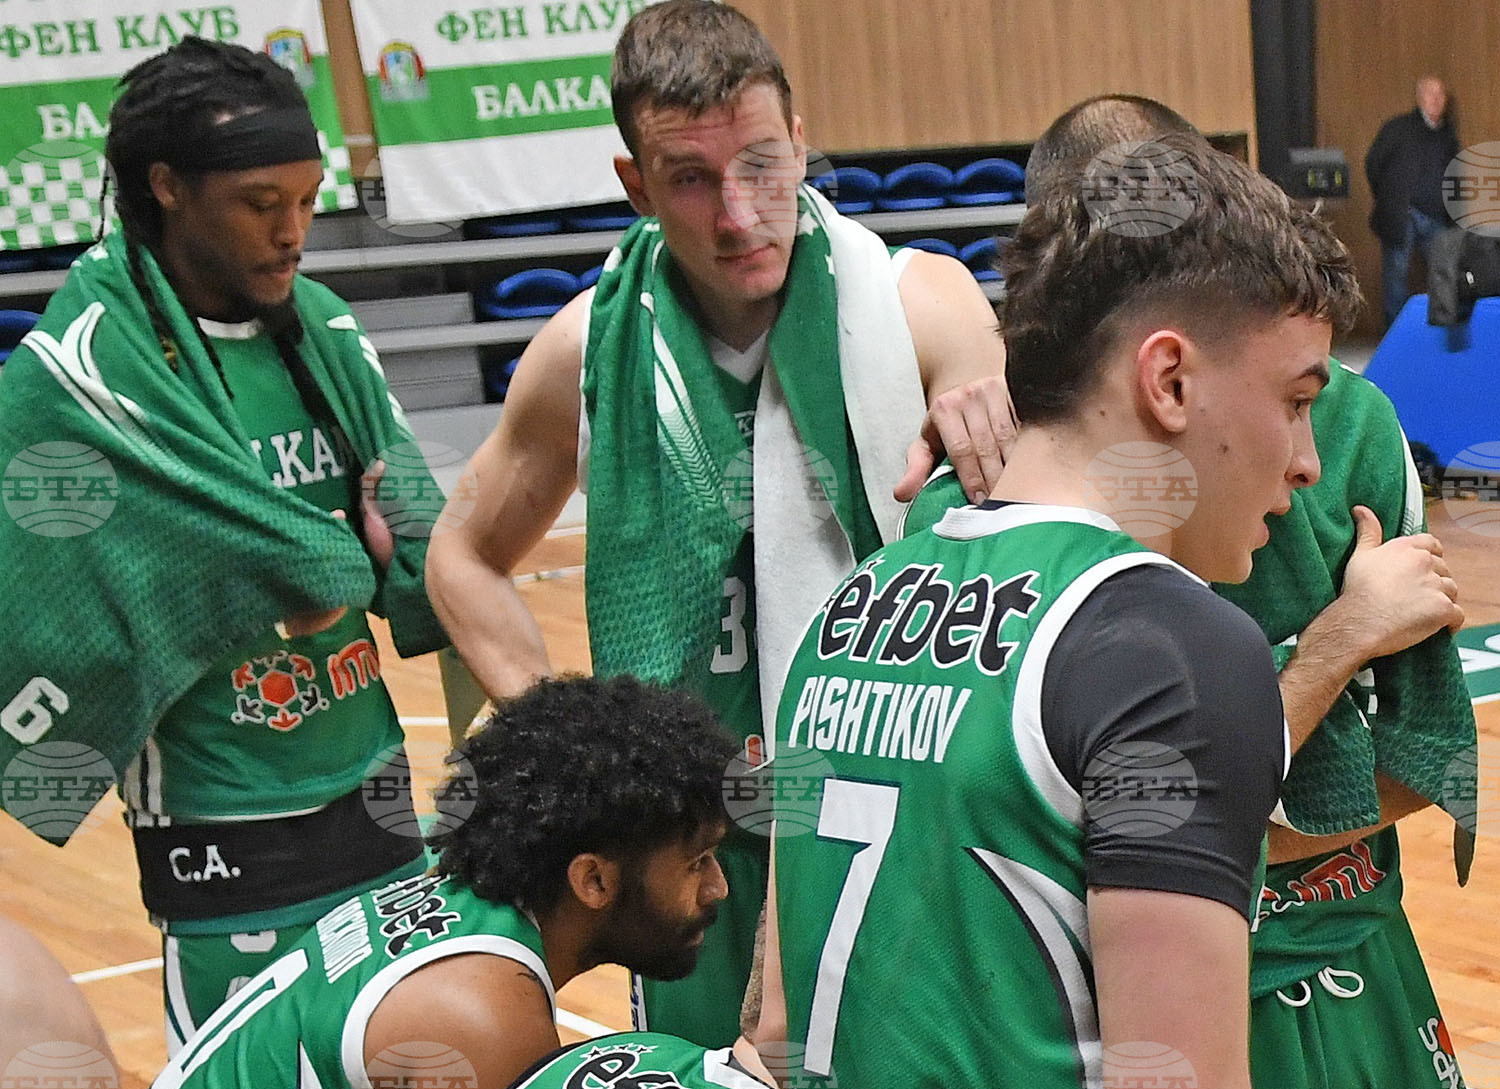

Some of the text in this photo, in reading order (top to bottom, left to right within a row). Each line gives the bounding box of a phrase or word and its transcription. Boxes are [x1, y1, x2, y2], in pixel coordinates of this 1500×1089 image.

[436, 7, 528, 43] ФЕН
[473, 74, 613, 121] БАЛКА
[818, 563, 1042, 677] efbet
[0, 676, 70, 745] 6
[787, 674, 973, 763] PISHTIKOV
[168, 844, 242, 883] C.A.
[802, 776, 901, 1078] 7
